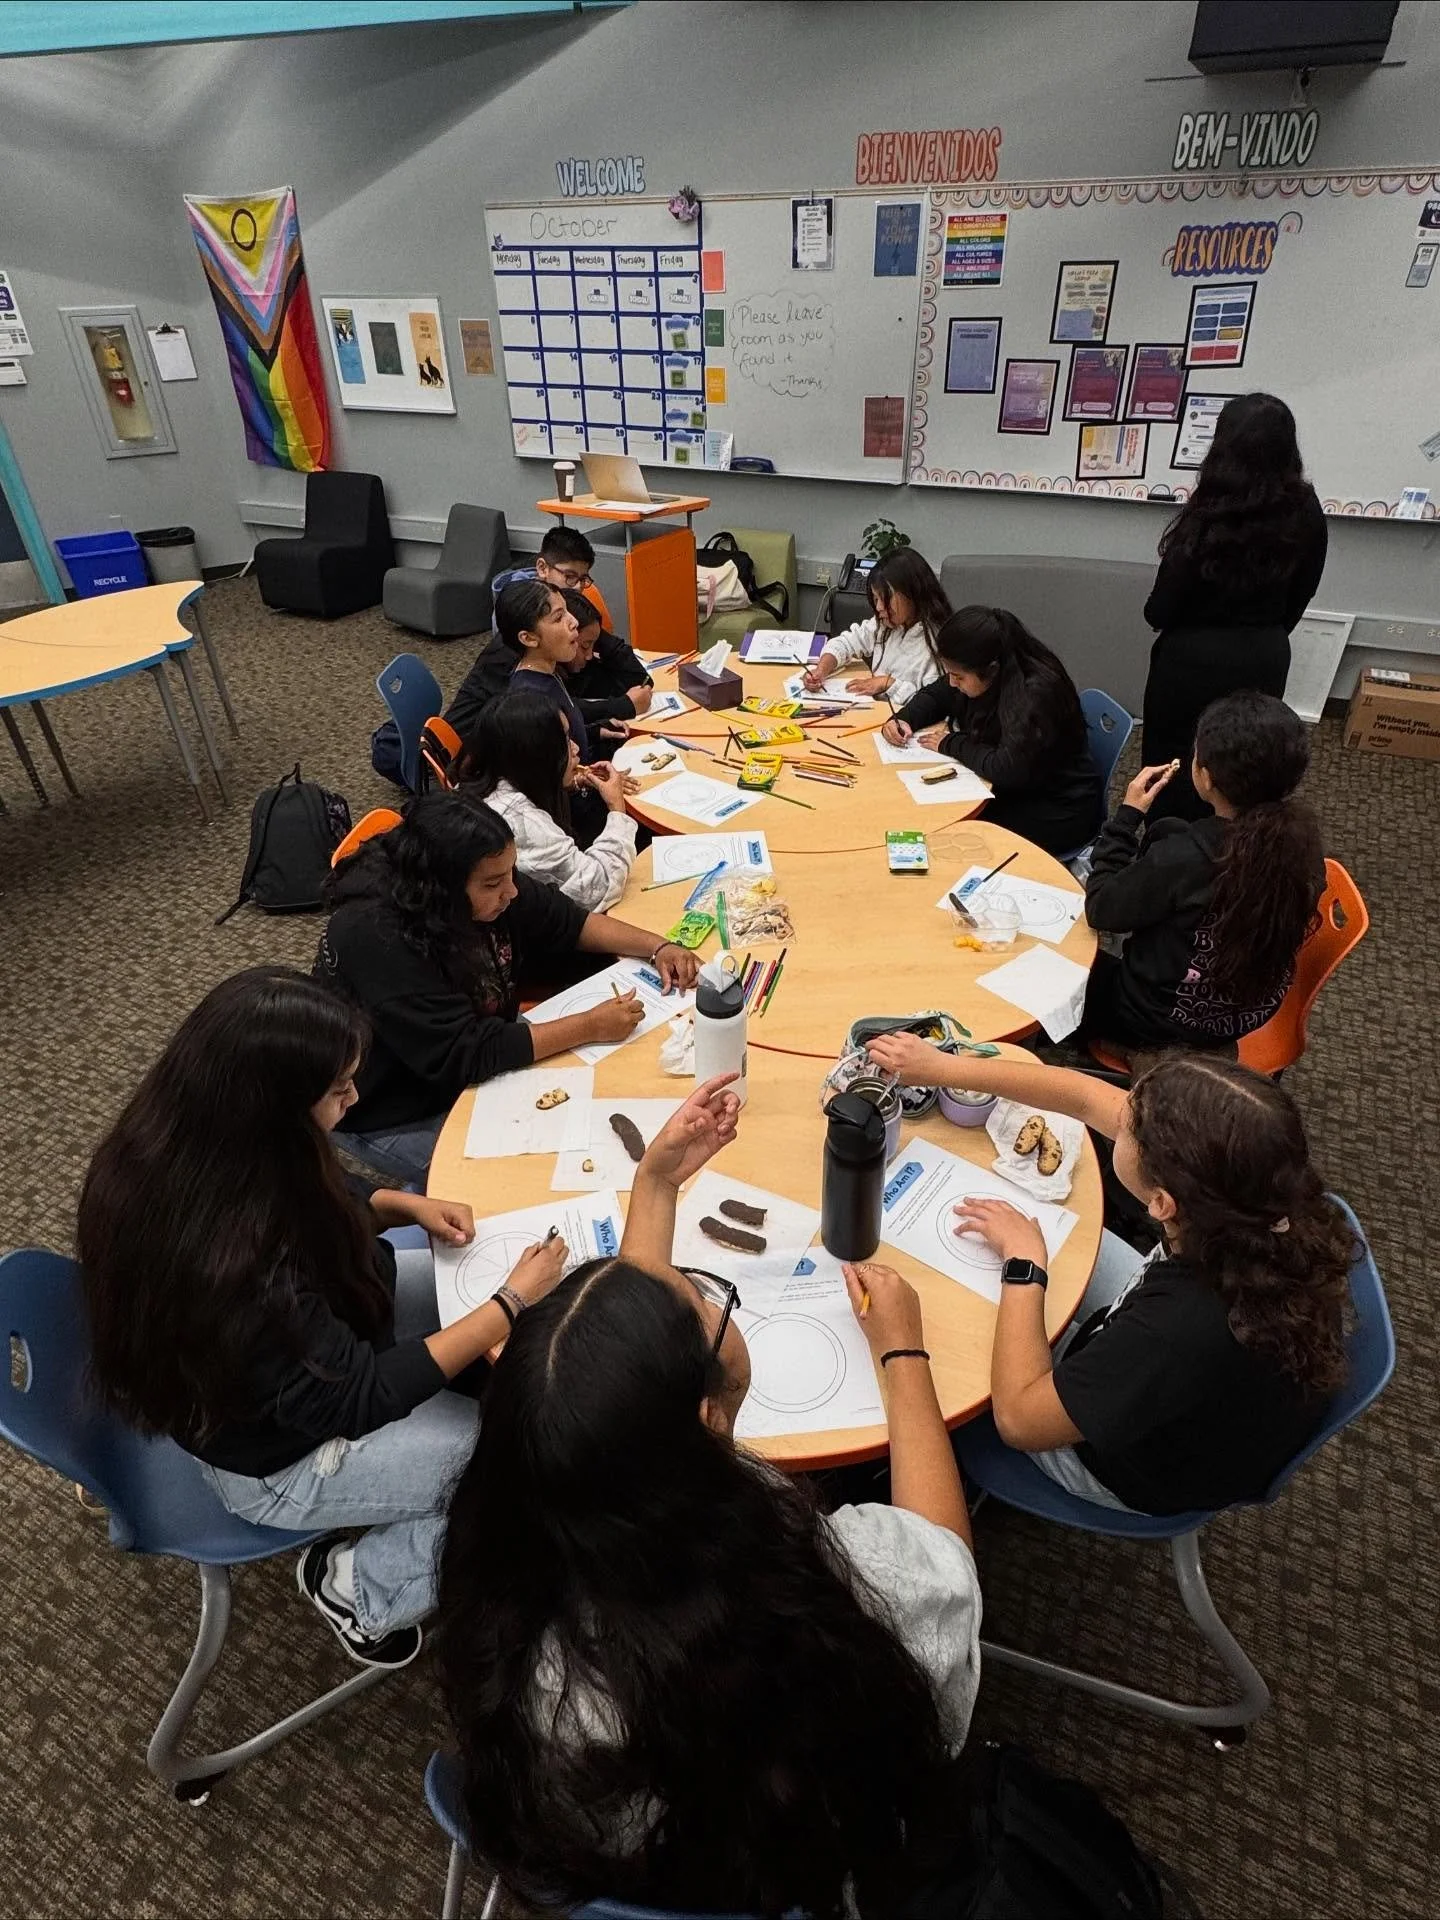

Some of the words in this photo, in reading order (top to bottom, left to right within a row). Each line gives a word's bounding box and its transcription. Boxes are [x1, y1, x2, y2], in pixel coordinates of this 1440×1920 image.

[1172, 109, 1320, 170] BEM-VINDO
[856, 127, 1001, 185] BIENVENIDOS
[556, 155, 646, 197] WELCOME
[530, 212, 618, 239] October
[1172, 224, 1277, 275] RESOURCES
[496, 254, 522, 268] Monday
[536, 252, 560, 266] Tuesday
[574, 255, 605, 266] Wednesday
[617, 254, 646, 268] Thursday
[660, 255, 684, 267] Friday
[648, 278, 653, 287] 2
[692, 274, 698, 284] 3
[569, 316, 574, 324] 7
[738, 305, 780, 329] Please
[786, 301, 823, 322] leave
[530, 316, 536, 325] 6
[652, 318, 657, 327] 9
[692, 317, 700, 326] 10
[740, 334, 773, 346] room
[778, 333, 795, 343] as
[800, 331, 823, 348] you
[532, 352, 540, 361] 13
[569, 352, 578, 362] 14
[609, 354, 618, 364] 15
[652, 356, 660, 365] 16
[693, 356, 702, 366] 17
[784, 354, 793, 363] it
[573, 391, 581, 399] 21
[613, 391, 622, 400] 22
[651, 392, 661, 401] 23
[695, 397, 704, 406] 24
[616, 429, 624, 438] 29
[654, 432, 663, 441] 30
[695, 434, 703, 443] 31
[93, 575, 128, 587] RECYCLE
[1376, 714, 1412, 726] Without
[1413, 721, 1431, 729] you,
[1388, 724, 1416, 735] empty
[1368, 736, 1392, 744] prime
[882, 1186, 899, 1204] Who
[898, 1174, 910, 1188] Am
[908, 1166, 916, 1178] I?
[600, 1220, 609, 1244] Who
